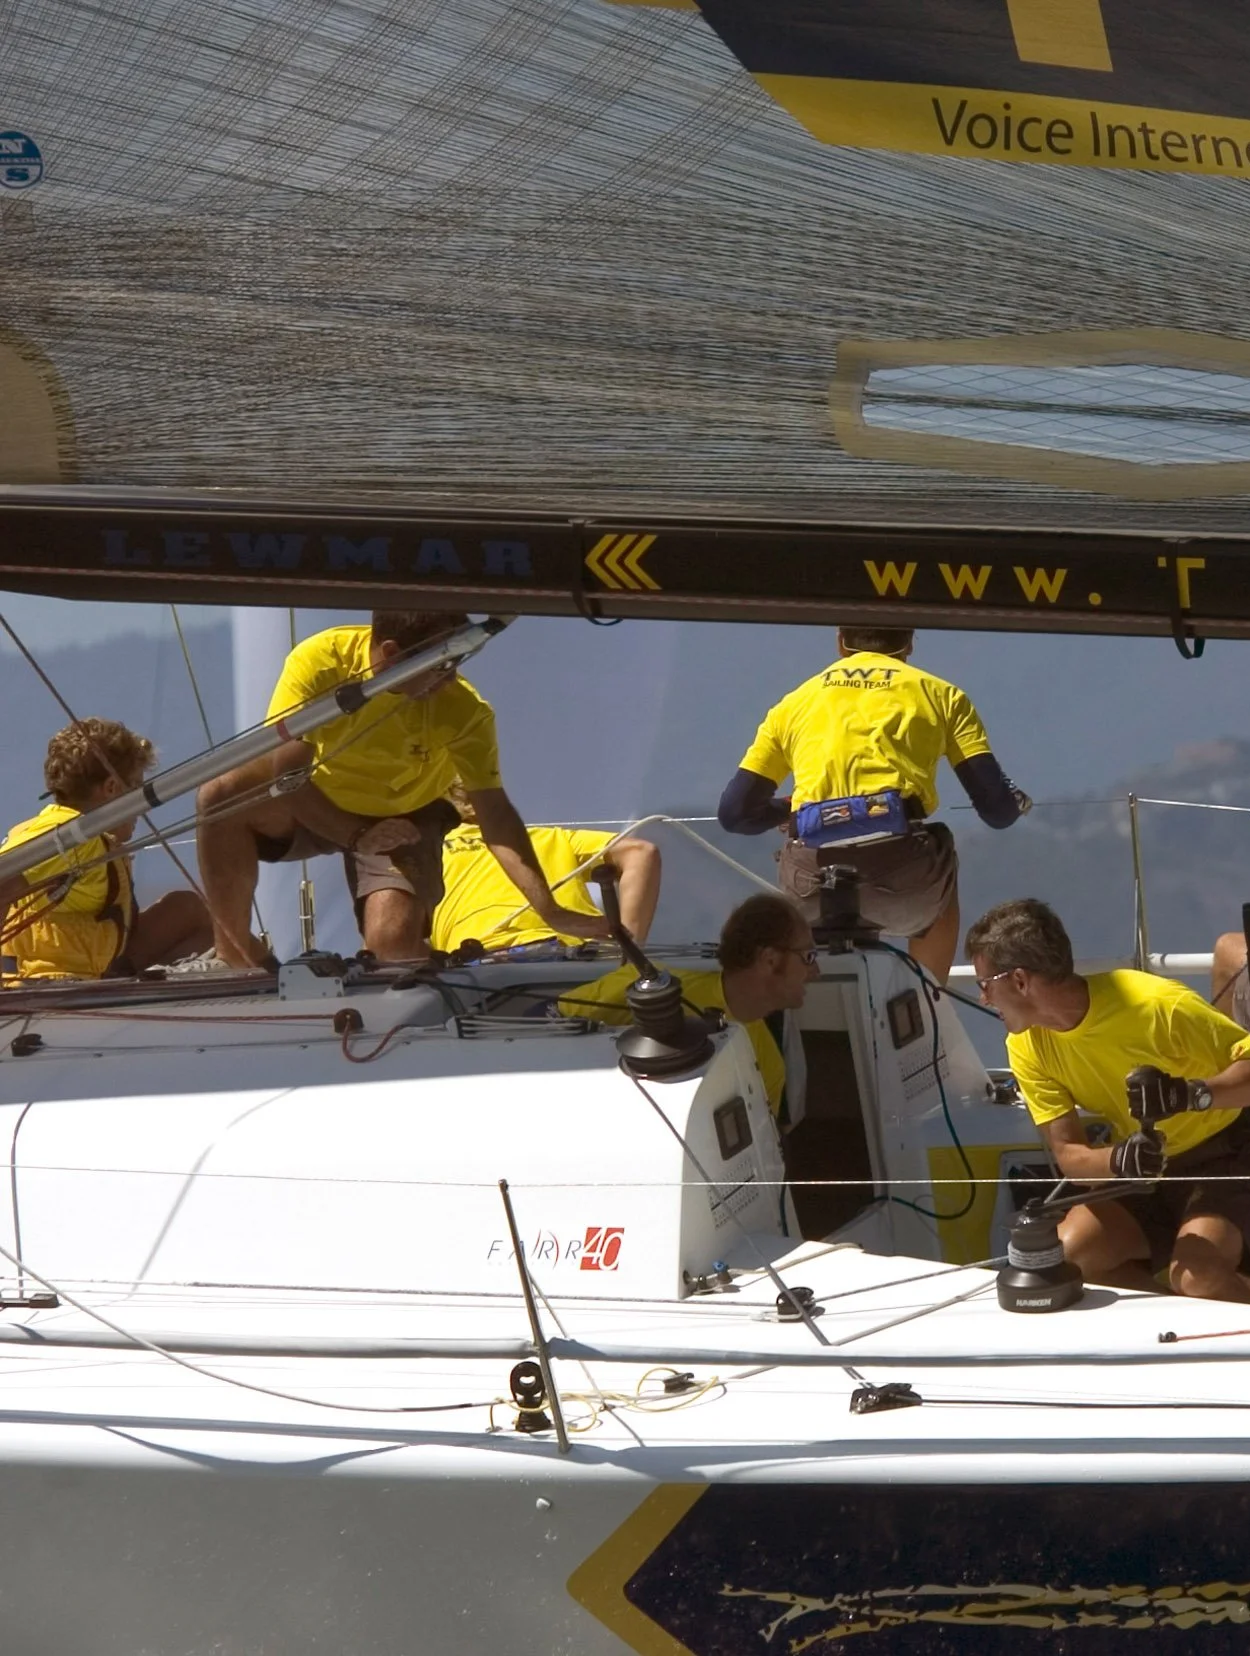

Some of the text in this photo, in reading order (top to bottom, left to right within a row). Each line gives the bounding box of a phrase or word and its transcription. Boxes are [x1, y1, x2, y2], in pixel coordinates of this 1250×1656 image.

[931, 96, 1073, 156] Voice
[101, 529, 535, 577] LEWMAR
[820, 667, 902, 682] TWT
[863, 680, 891, 690] TEAM
[582, 1228, 626, 1271] 40
